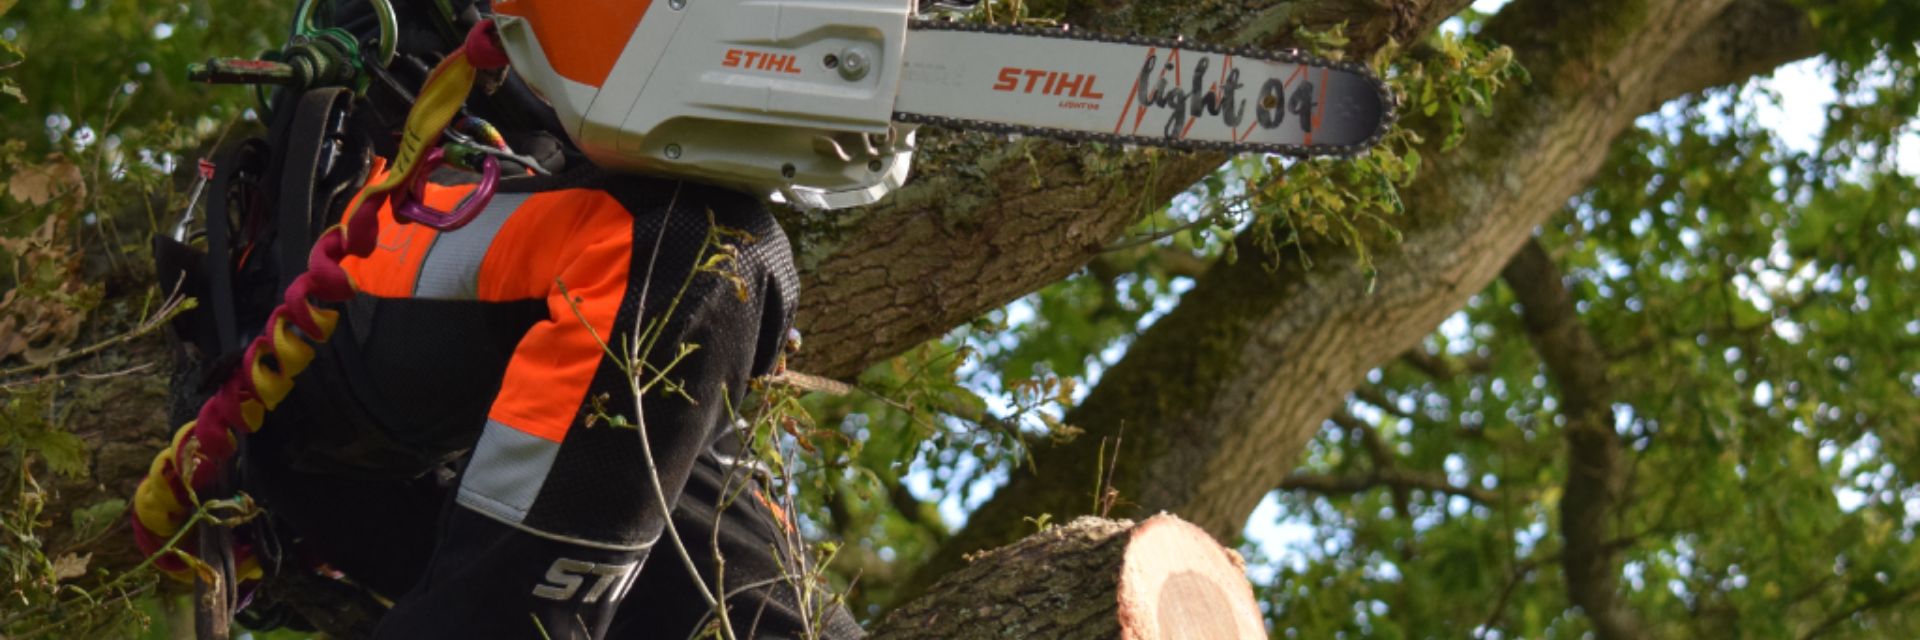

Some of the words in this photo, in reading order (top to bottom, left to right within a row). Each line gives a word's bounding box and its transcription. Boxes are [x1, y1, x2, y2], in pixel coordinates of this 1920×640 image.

[722, 49, 801, 74] STIHL
[992, 66, 1104, 99] STIHL
[1138, 55, 1246, 139] light
